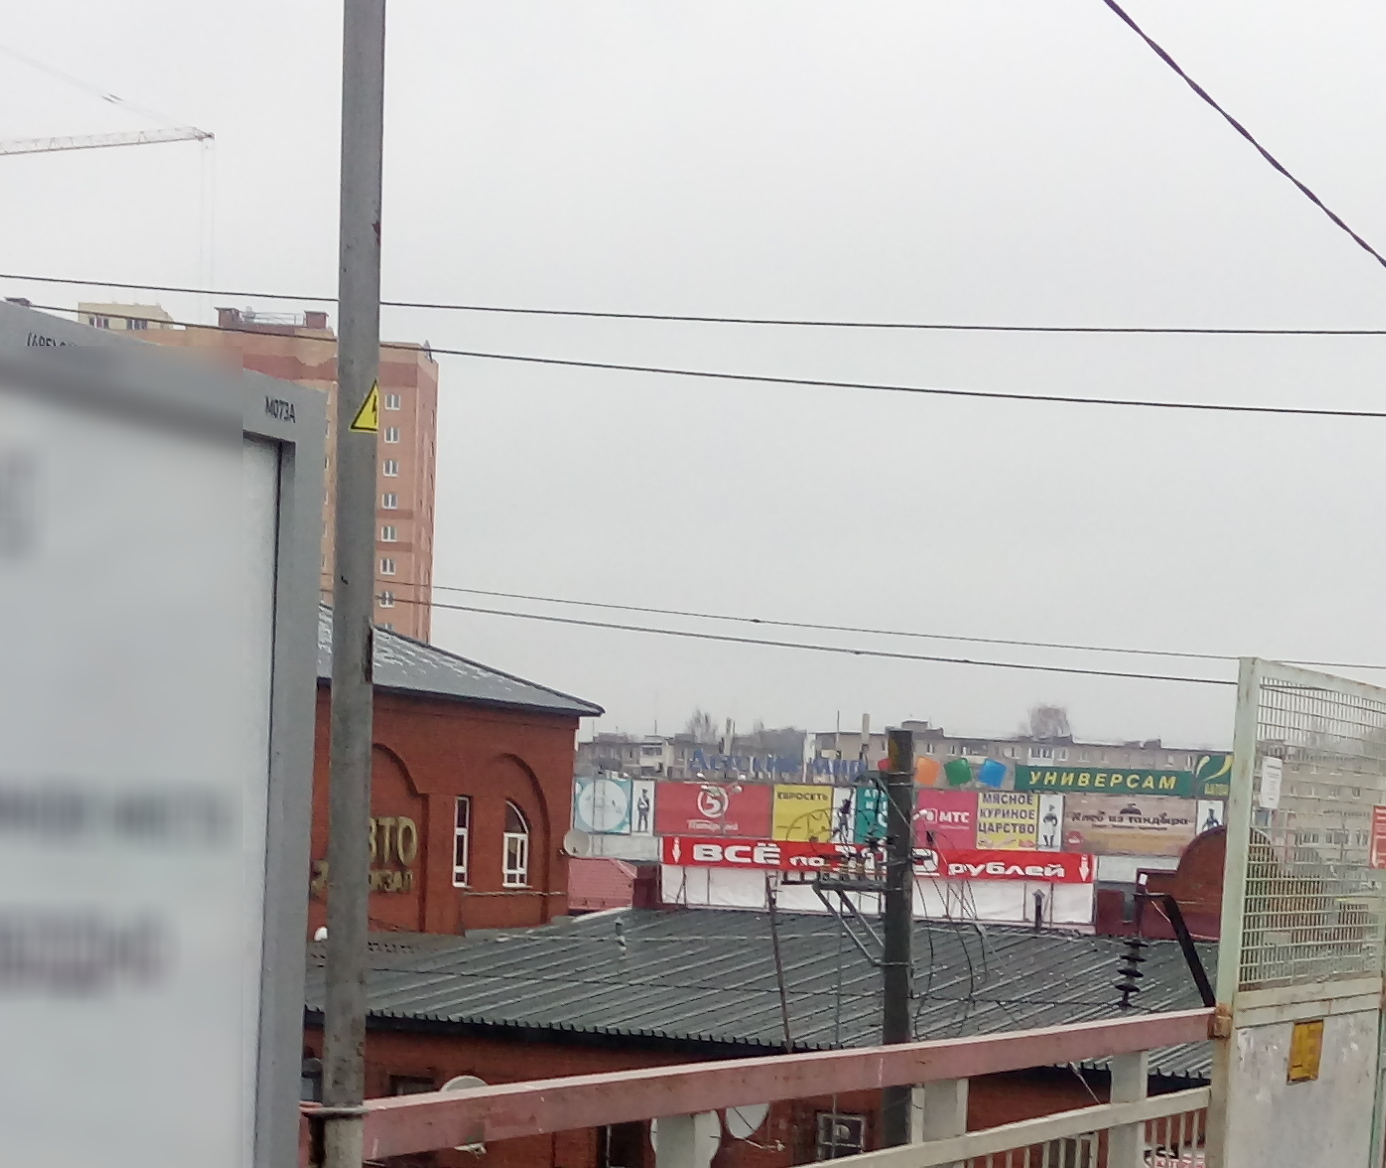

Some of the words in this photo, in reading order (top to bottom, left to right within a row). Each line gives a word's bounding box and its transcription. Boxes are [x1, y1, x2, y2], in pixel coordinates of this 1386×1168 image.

[1028, 770, 1177, 790] УНИВЕРСАМ
[982, 793, 1033, 805] МЯСНОЕ
[939, 811, 970, 823] МТС
[979, 808, 1035, 820] КУРИНОЕ
[978, 822, 1035, 834] ЦАРСТВО
[693, 843, 781, 865] ВСЁ
[789, 855, 825, 867] по
[947, 861, 1066, 877] рублей
